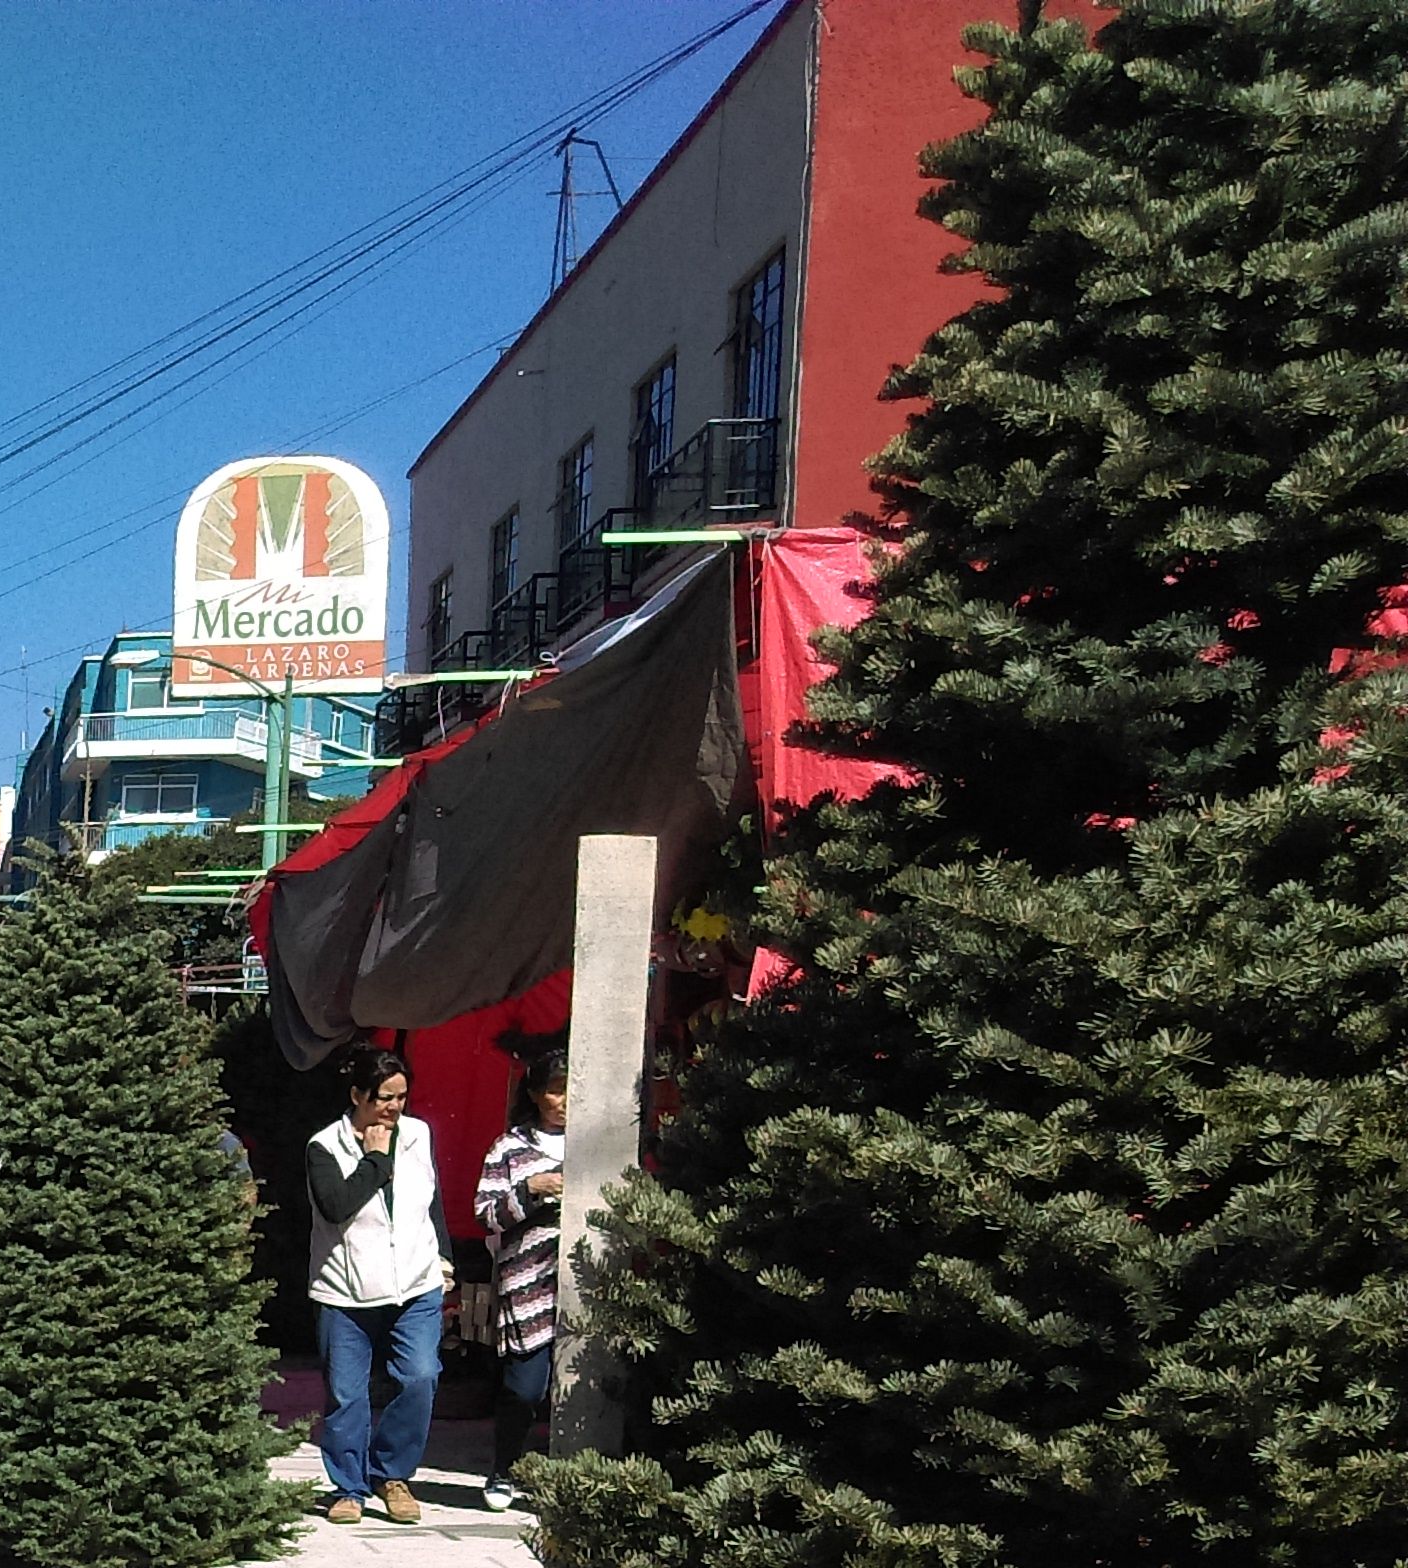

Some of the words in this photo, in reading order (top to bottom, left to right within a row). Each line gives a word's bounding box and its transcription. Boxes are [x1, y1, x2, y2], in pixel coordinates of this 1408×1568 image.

[234, 582, 314, 607] Mi
[192, 594, 364, 640] Mercado
[246, 643, 350, 663] LAZARO
[231, 659, 366, 680] CARDENAS
